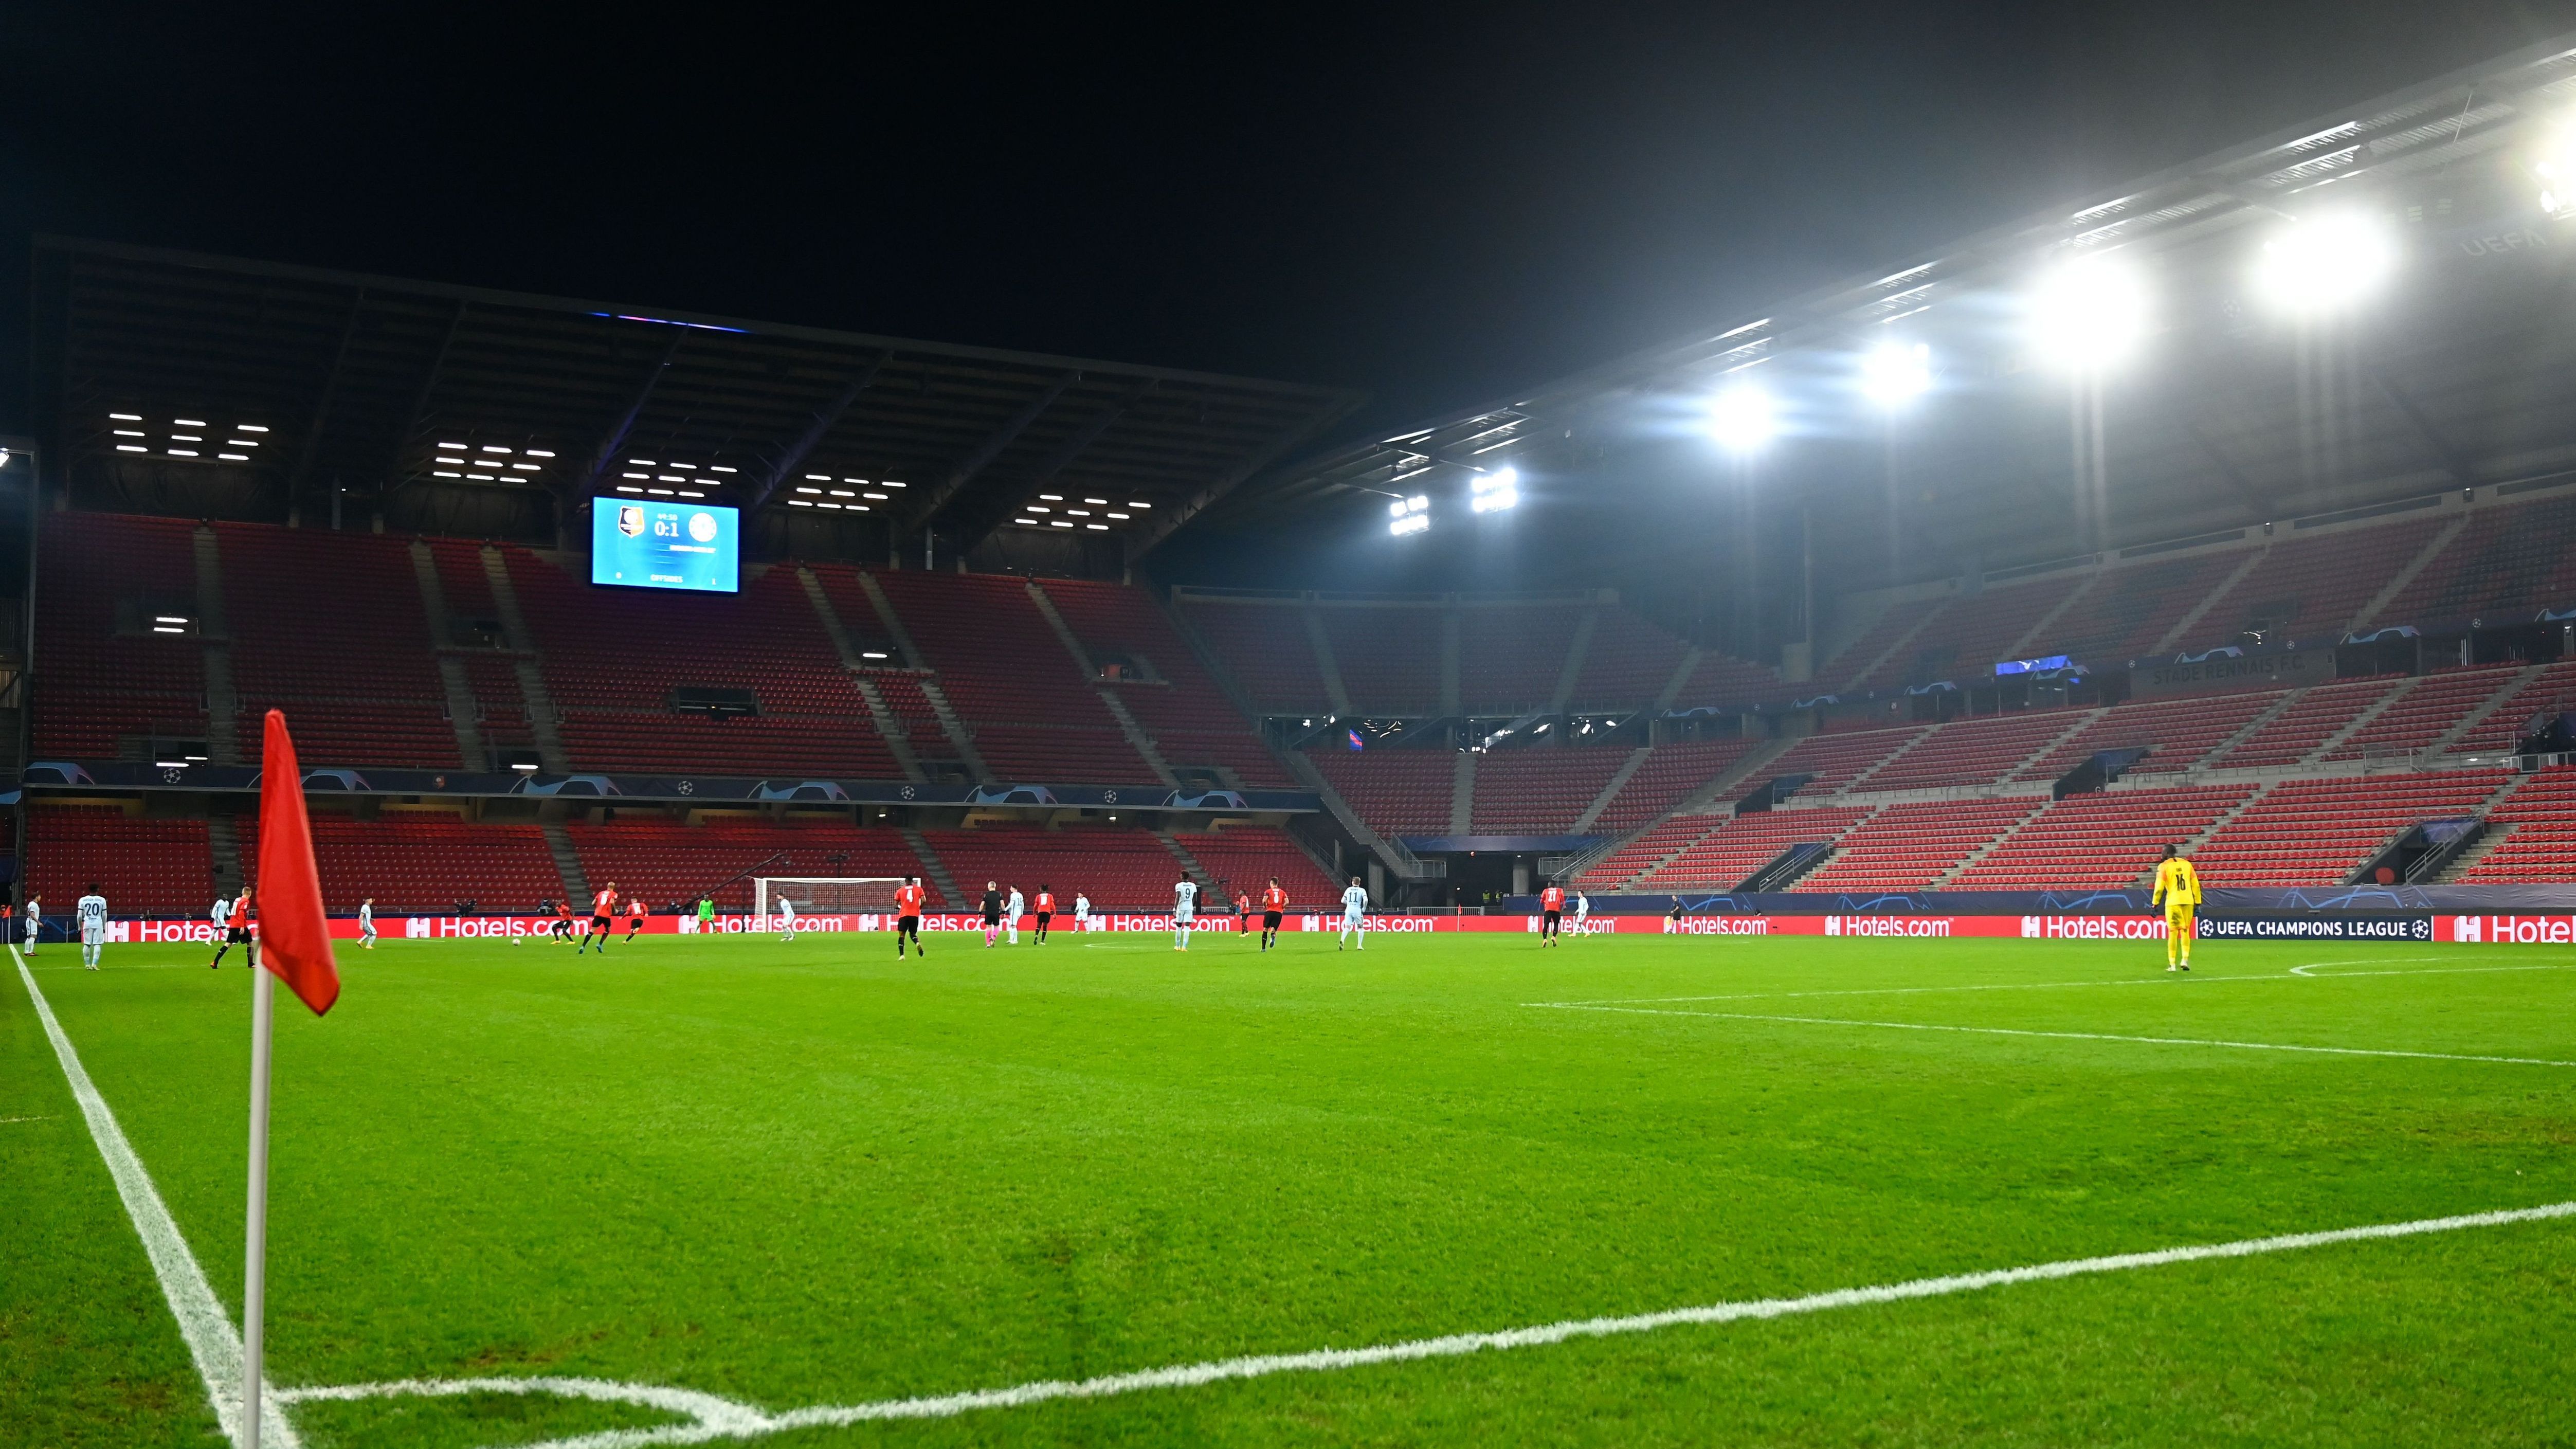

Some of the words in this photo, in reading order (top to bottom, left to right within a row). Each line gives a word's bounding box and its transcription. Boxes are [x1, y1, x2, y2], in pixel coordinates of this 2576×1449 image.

[2460, 228, 2547, 256] UEFA
[654, 520, 679, 537] 0:1
[2154, 667, 2200, 685] STADE
[2205, 657, 2274, 679] RENNAIS
[2175, 874, 2186, 891] 16
[1185, 888, 1191, 899] 9
[1348, 892, 1358, 903] 11
[85, 903, 100, 916] 20
[2217, 921, 2253, 935] UEFA
[2256, 921, 2342, 936] CHAMPIONS
[2348, 921, 2407, 936] LEAGUE
